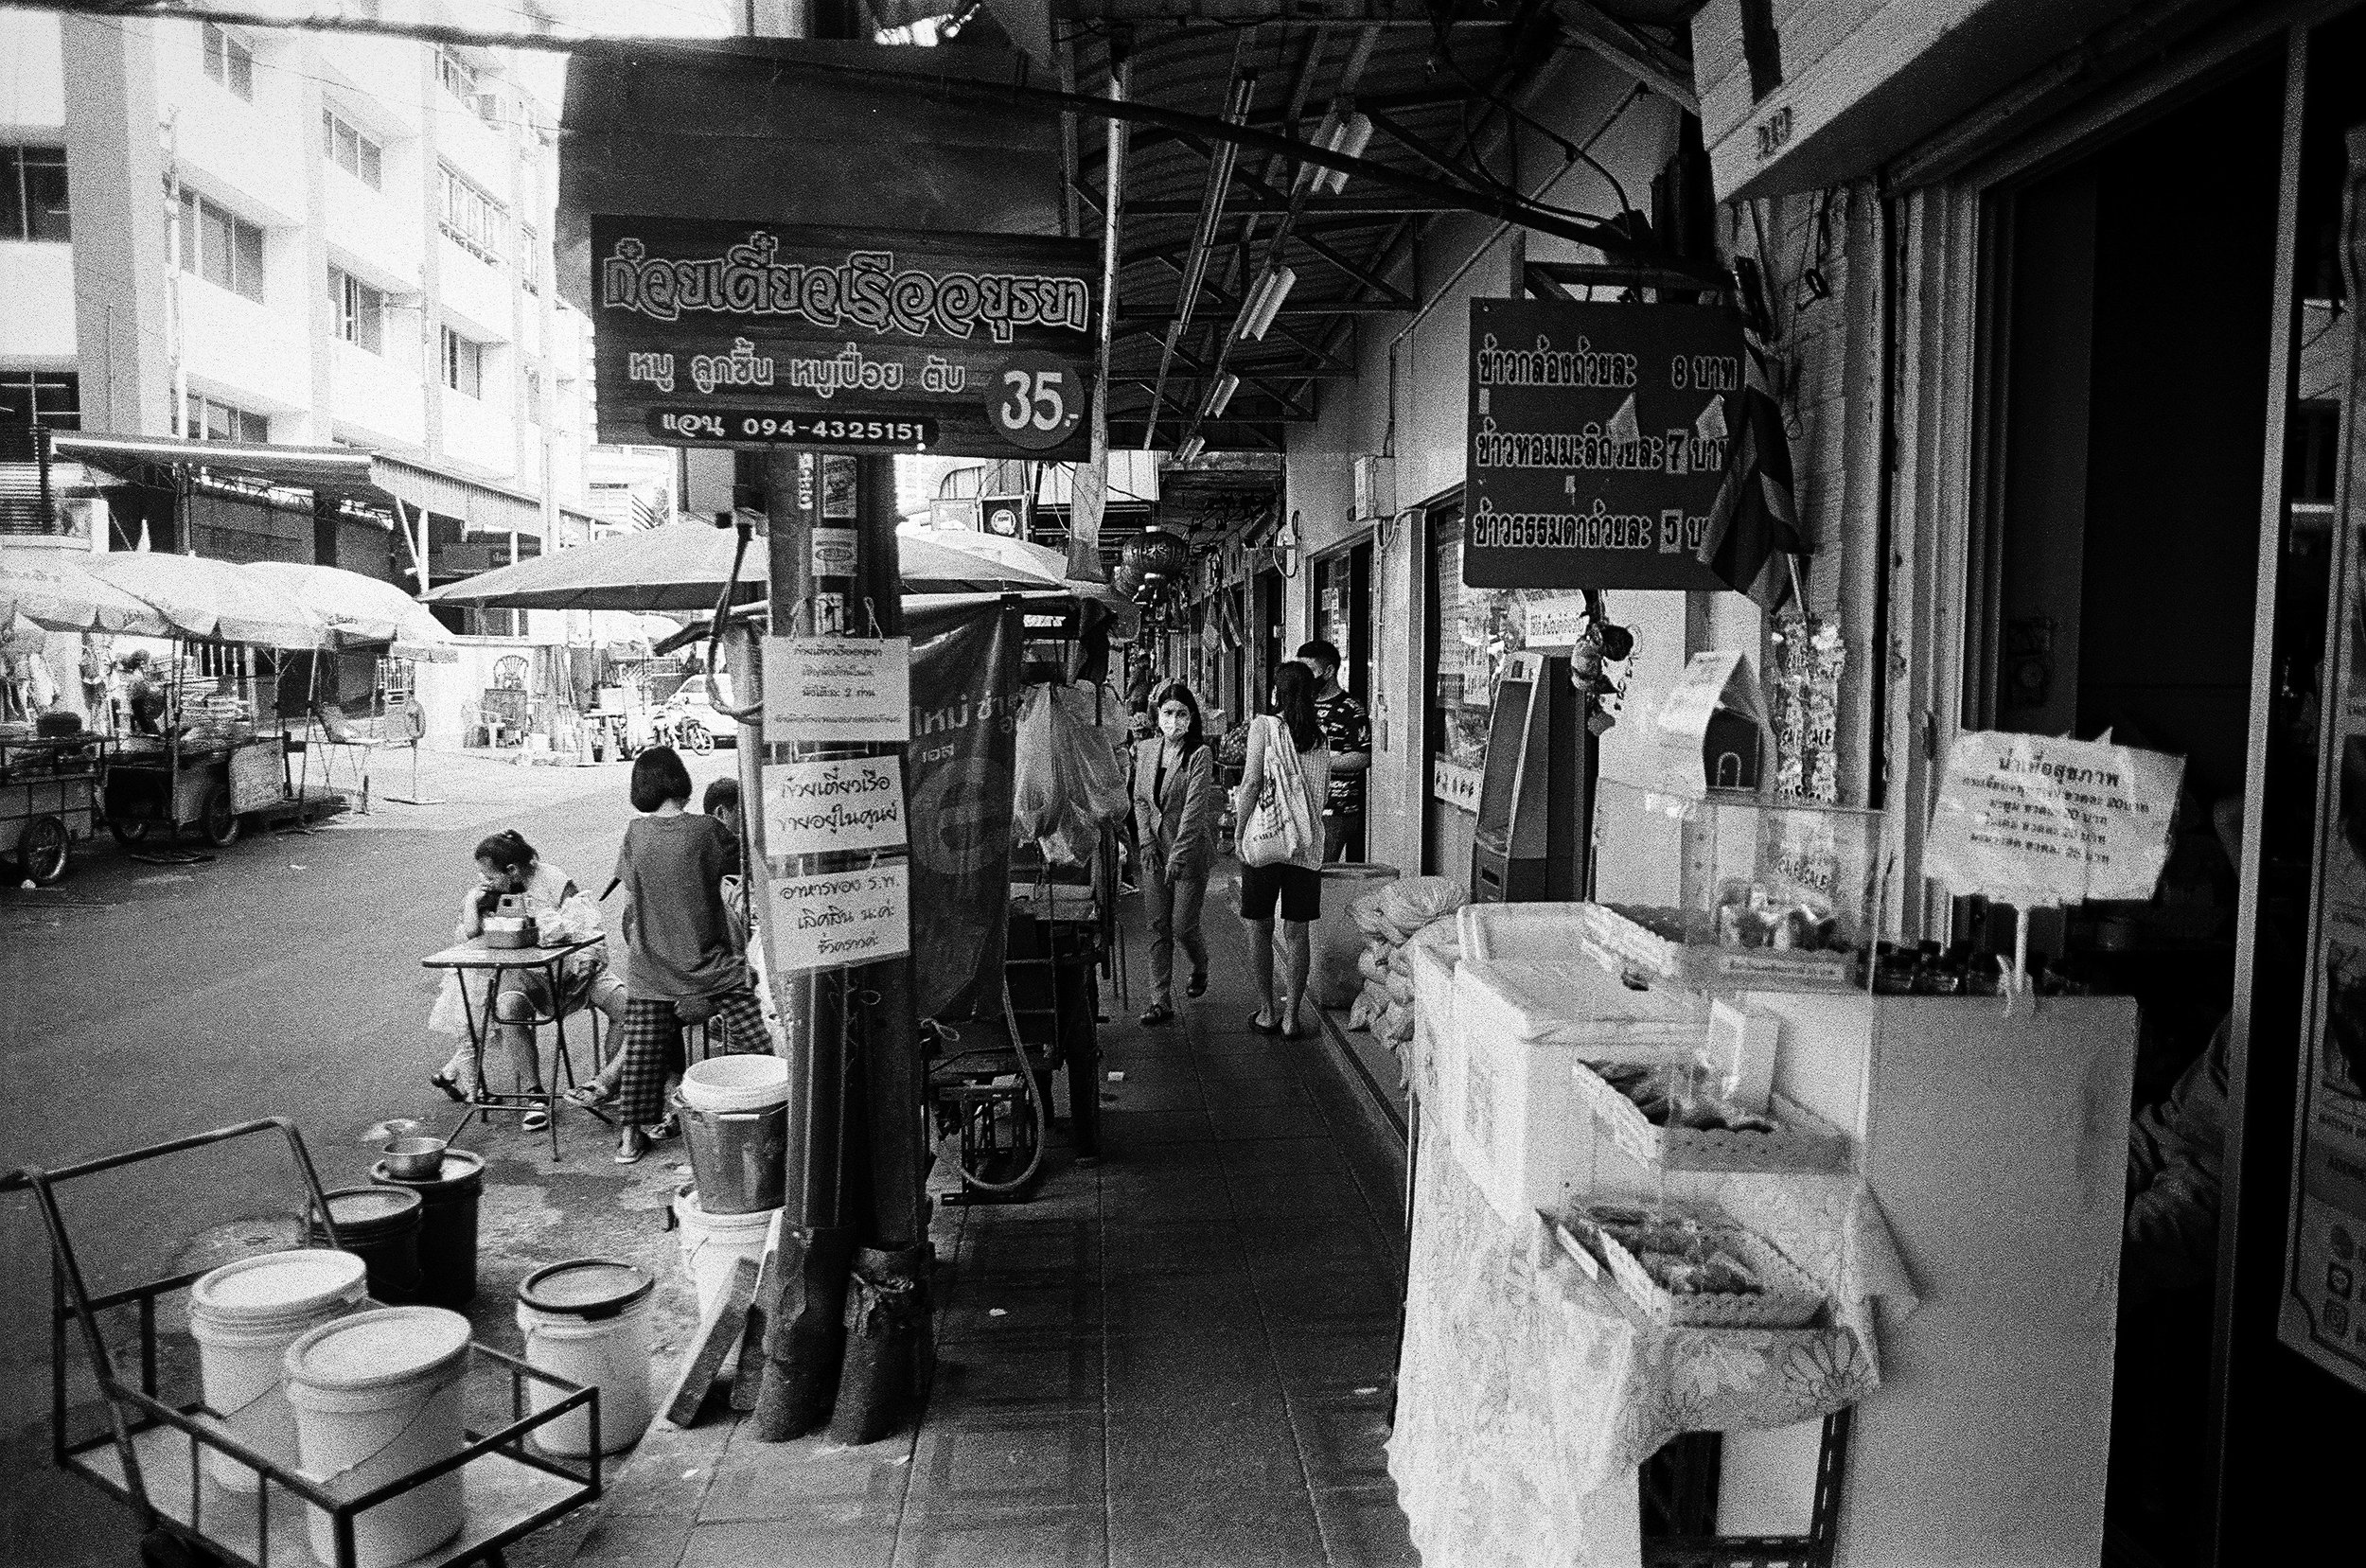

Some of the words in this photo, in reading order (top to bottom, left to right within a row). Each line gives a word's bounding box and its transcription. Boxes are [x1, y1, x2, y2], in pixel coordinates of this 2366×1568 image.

[603, 230, 1088, 344] ก๋วยเตี๋ยวเรืออยุธยา
[628, 348, 675, 393] หมู
[691, 336, 774, 394] ลูกชิ้น
[790, 342, 904, 398] หมูเปื่อย
[922, 355, 966, 395] ตับ
[1671, 355, 1688, 390] 8
[1693, 355, 1738, 391] บาท
[743, 415, 925, 444] 094-4325151
[1666, 432, 1686, 472] 7
